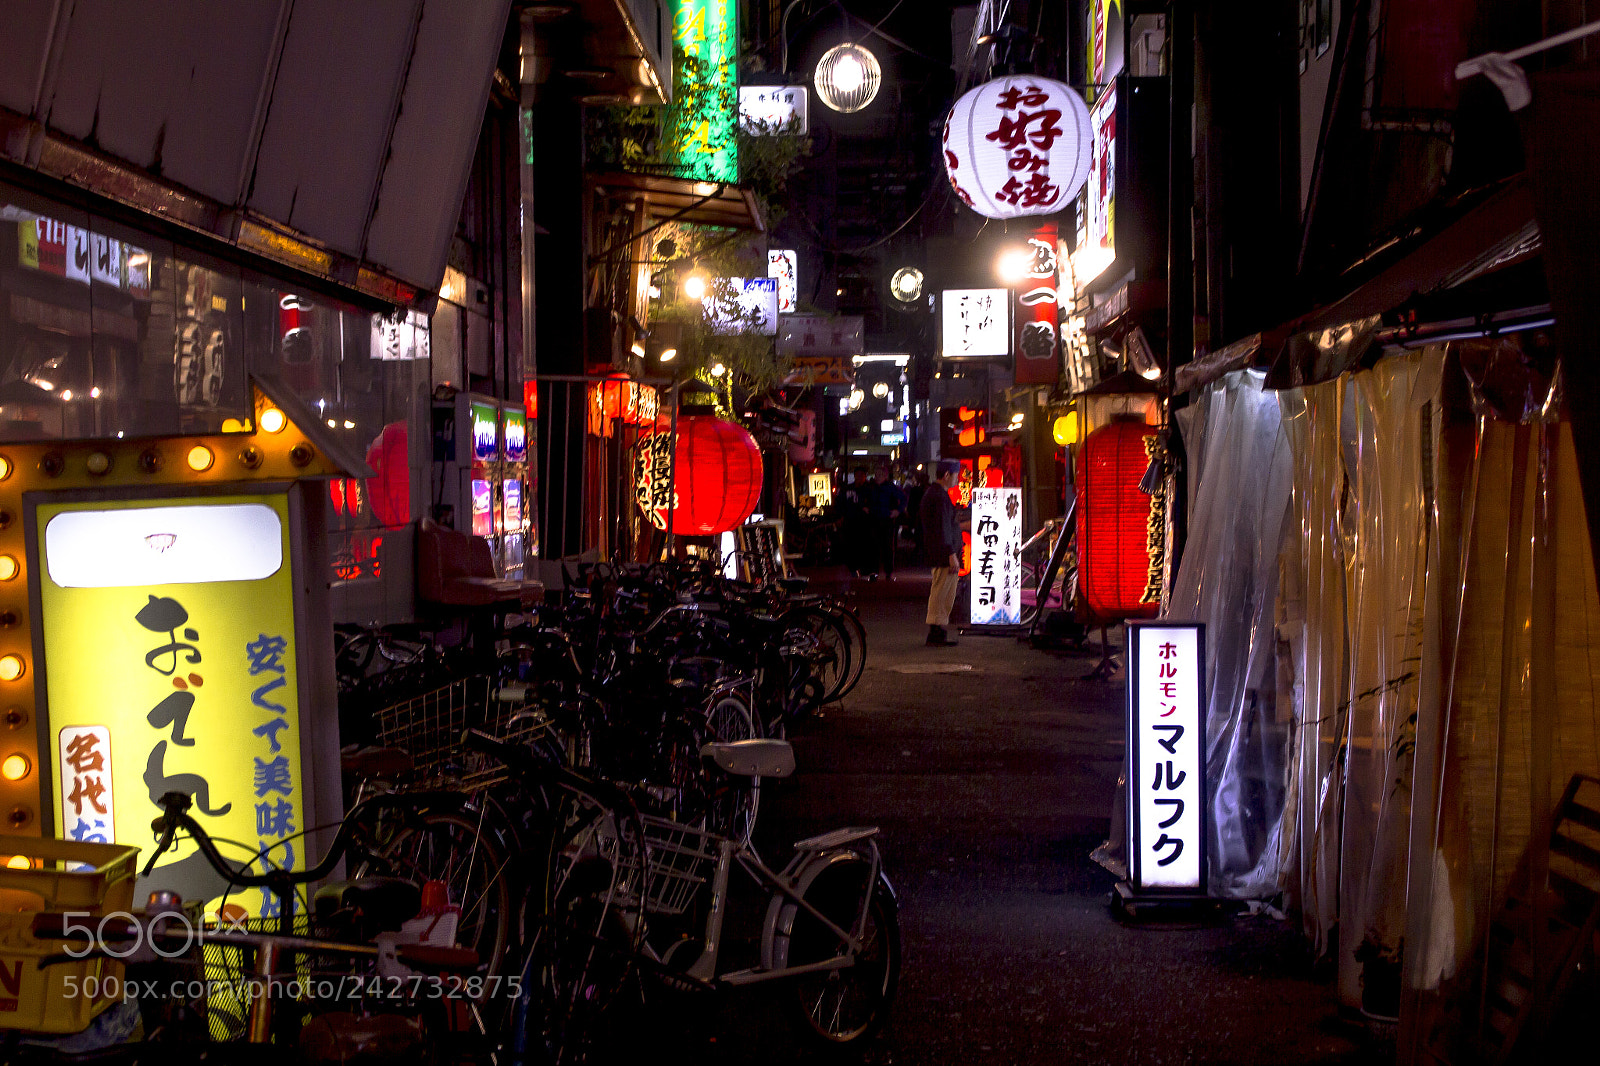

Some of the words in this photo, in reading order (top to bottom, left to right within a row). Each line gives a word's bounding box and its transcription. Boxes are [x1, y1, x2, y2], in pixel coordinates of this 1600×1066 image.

[986, 86, 1063, 208] お好み焼
[134, 594, 232, 816] おでん
[1158, 641, 1178, 717] ホルモン
[1152, 724, 1187, 867] マルフク
